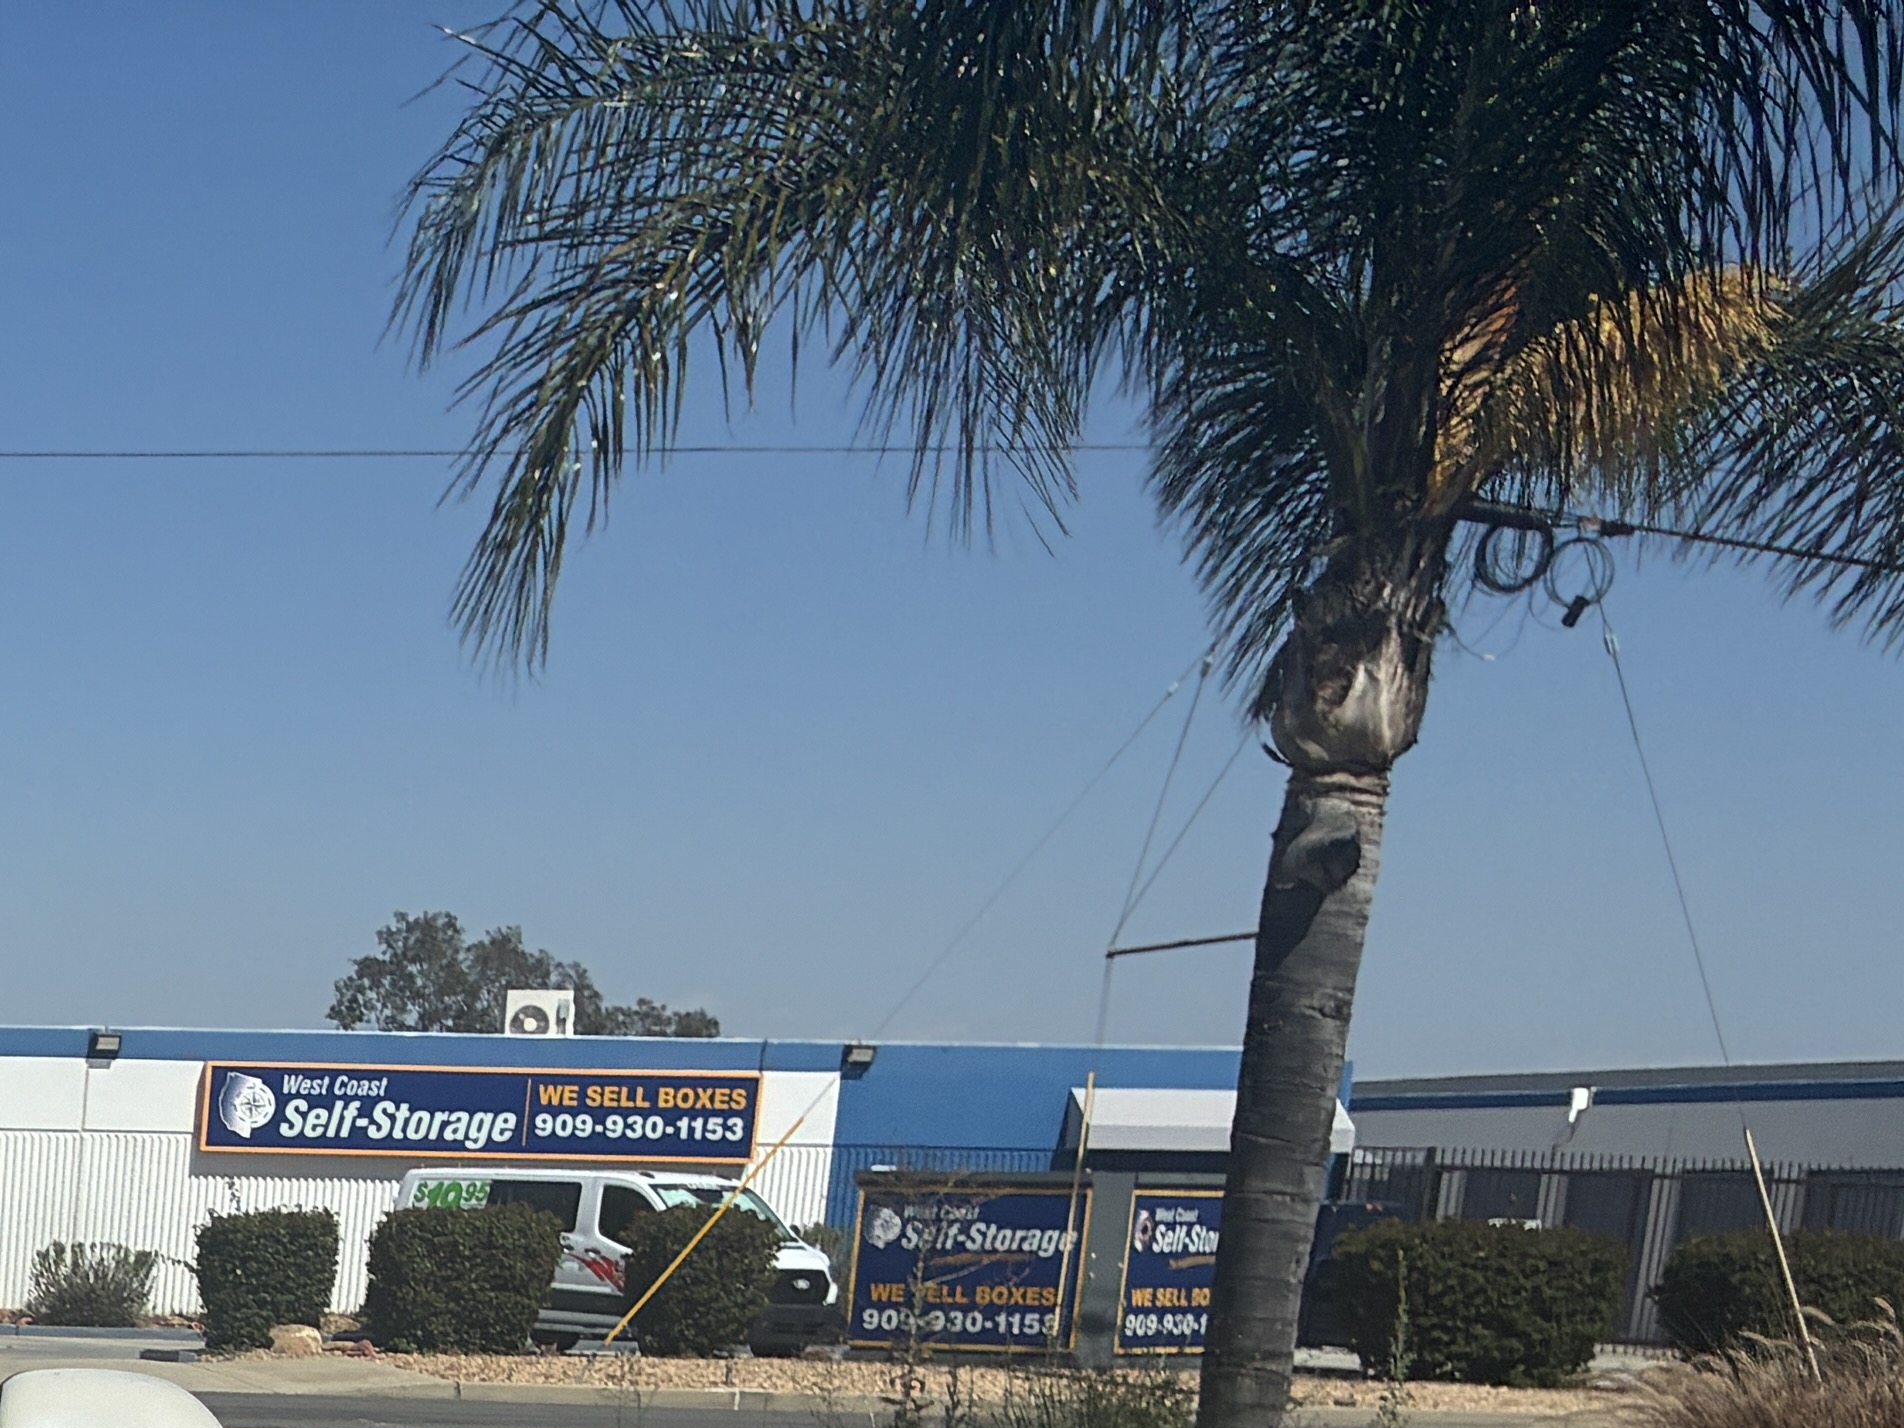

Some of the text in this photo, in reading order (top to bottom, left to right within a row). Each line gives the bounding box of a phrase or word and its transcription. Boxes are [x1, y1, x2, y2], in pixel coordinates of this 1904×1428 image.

[282, 1074, 388, 1097] West Coast
[539, 1084, 747, 1110] WE SELL BOXES
[279, 1099, 517, 1149] Self-Storage
[534, 1113, 744, 1141] 909-930-1153
[871, 1283, 1057, 1306] WE ELL BOXES
[1132, 1288, 1153, 1307] WE
[1155, 1288, 1188, 1307] SELL
